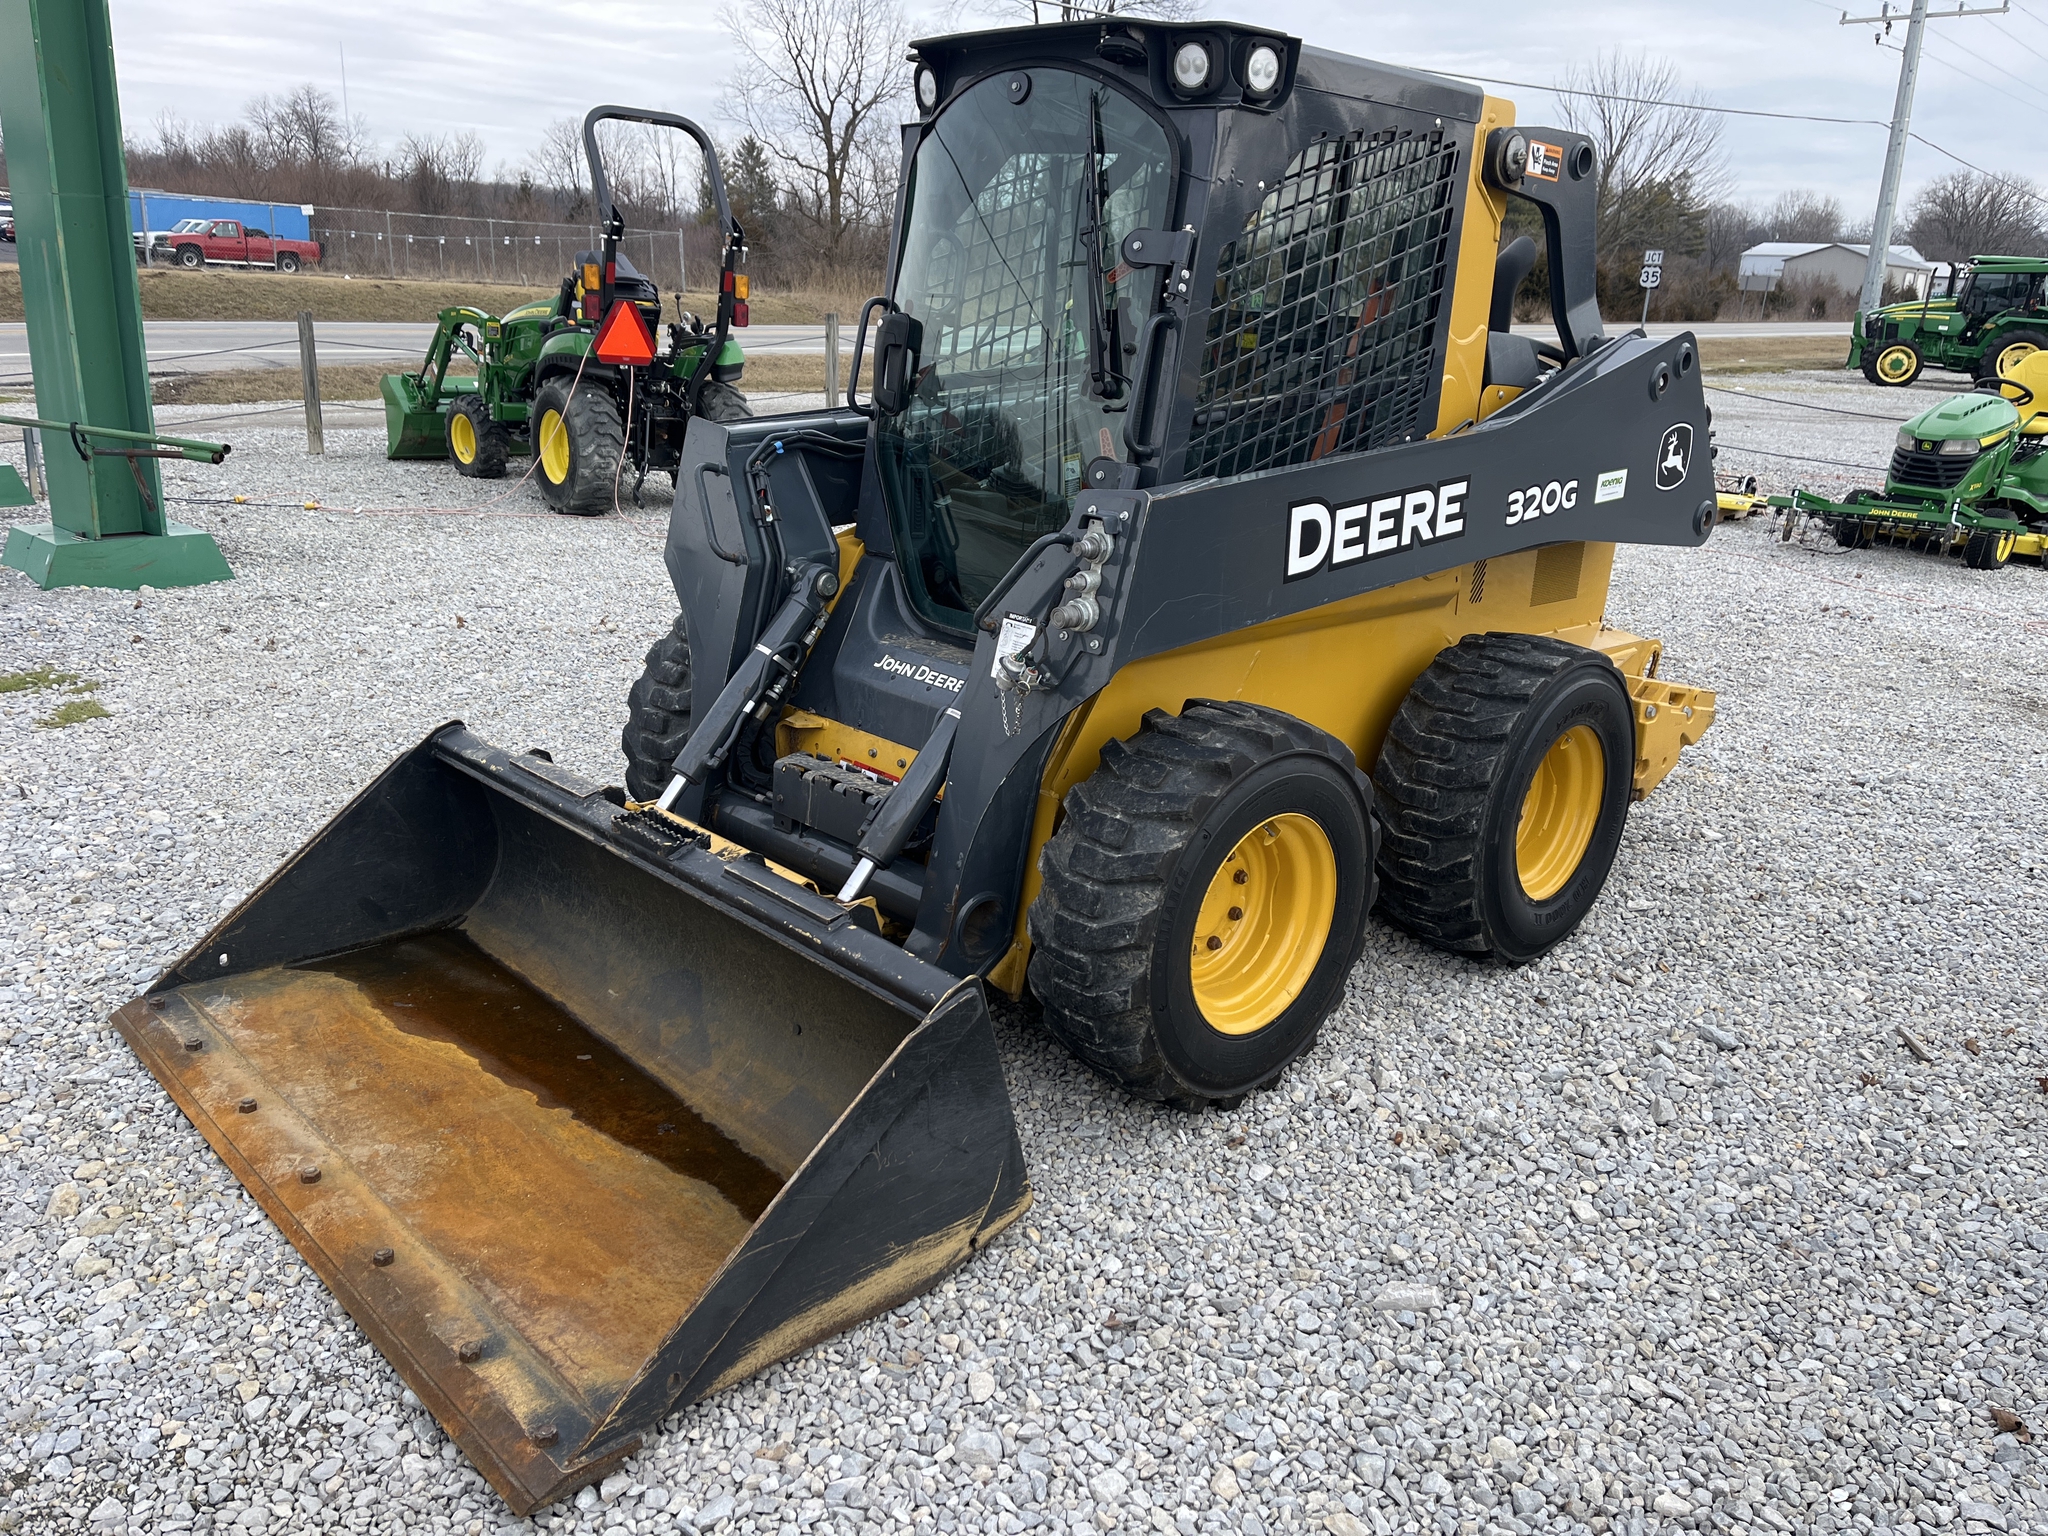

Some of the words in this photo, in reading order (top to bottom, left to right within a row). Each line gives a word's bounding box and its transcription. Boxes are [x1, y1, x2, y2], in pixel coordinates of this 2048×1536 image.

[1641, 270, 1659, 284] 35
[1645, 252, 1662, 263] JCT
[1505, 480, 1578, 525] 320G
[1868, 508, 1891, 517] JOHN
[1891, 509, 1919, 519] DEERE
[1287, 480, 1468, 576] DEERE
[873, 654, 917, 678] JOHN
[913, 664, 965, 693] DEERE
[1156, 866, 1189, 960] ALLIANCE
